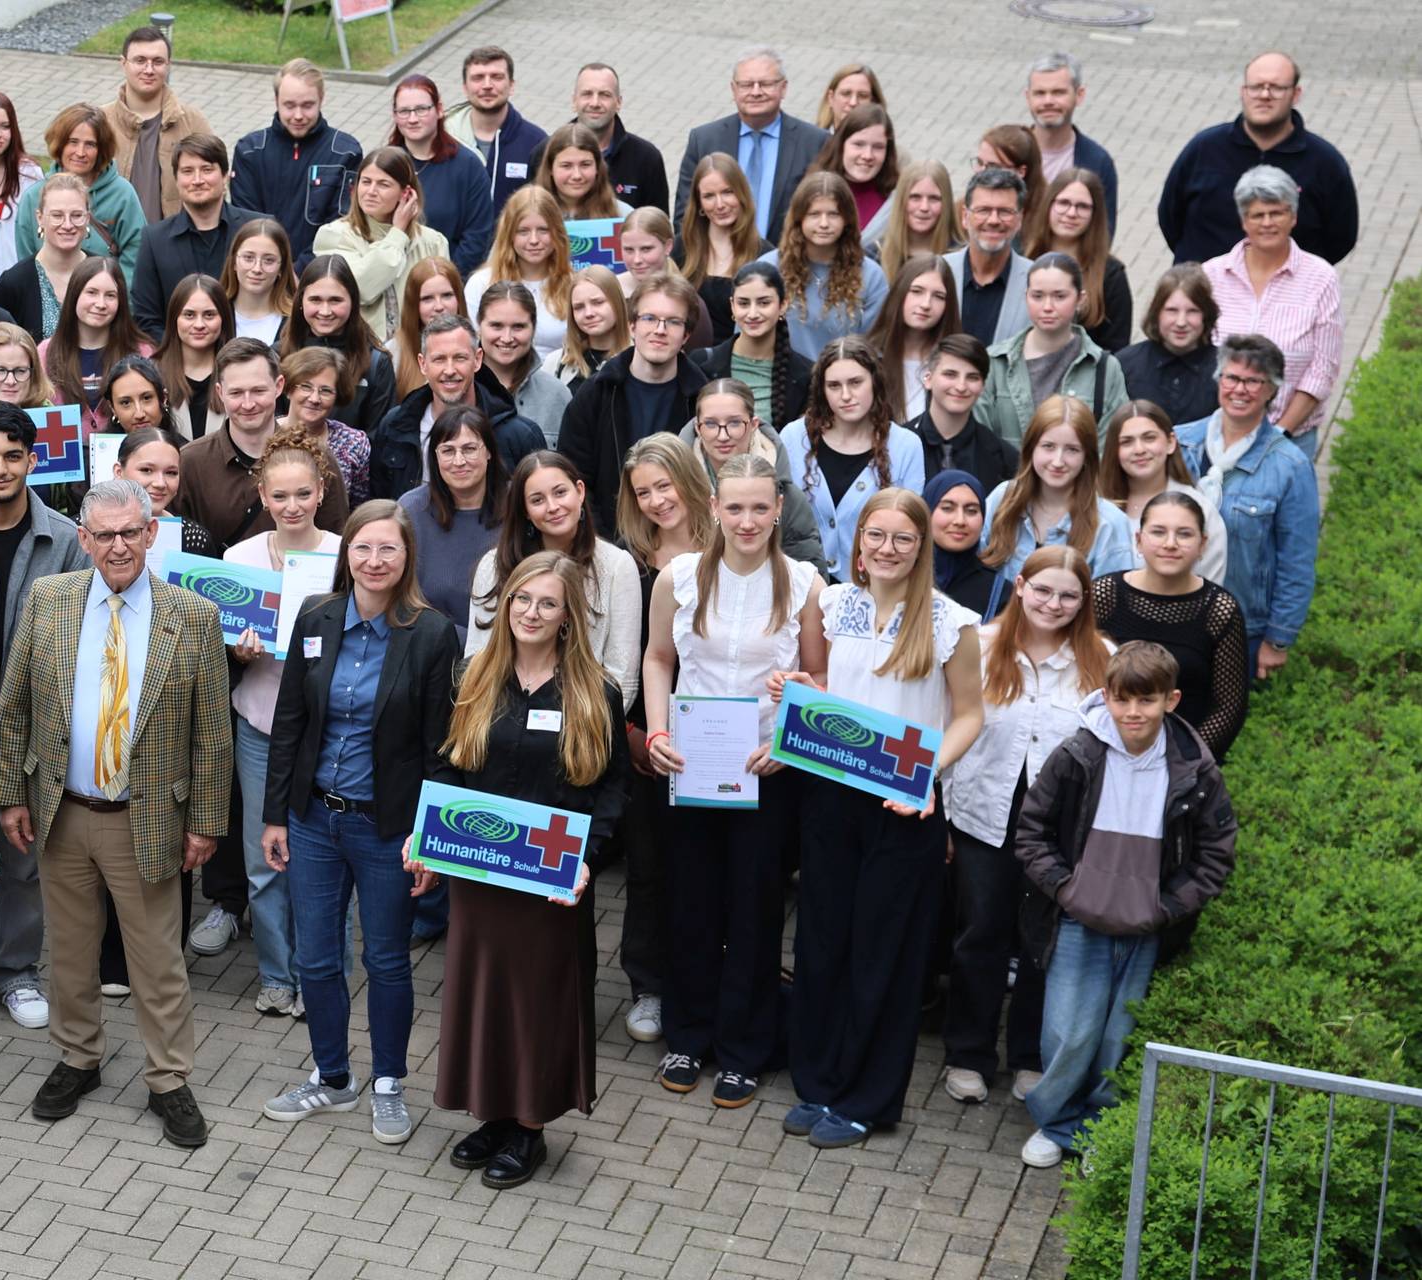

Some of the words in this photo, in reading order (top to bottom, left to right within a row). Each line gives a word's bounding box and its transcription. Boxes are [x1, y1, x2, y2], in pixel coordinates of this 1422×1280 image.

[786, 731, 867, 771] Humanitäre
[869, 765, 895, 780] Schule
[425, 834, 511, 867] Humanitäre
[513, 860, 540, 874] Schule
